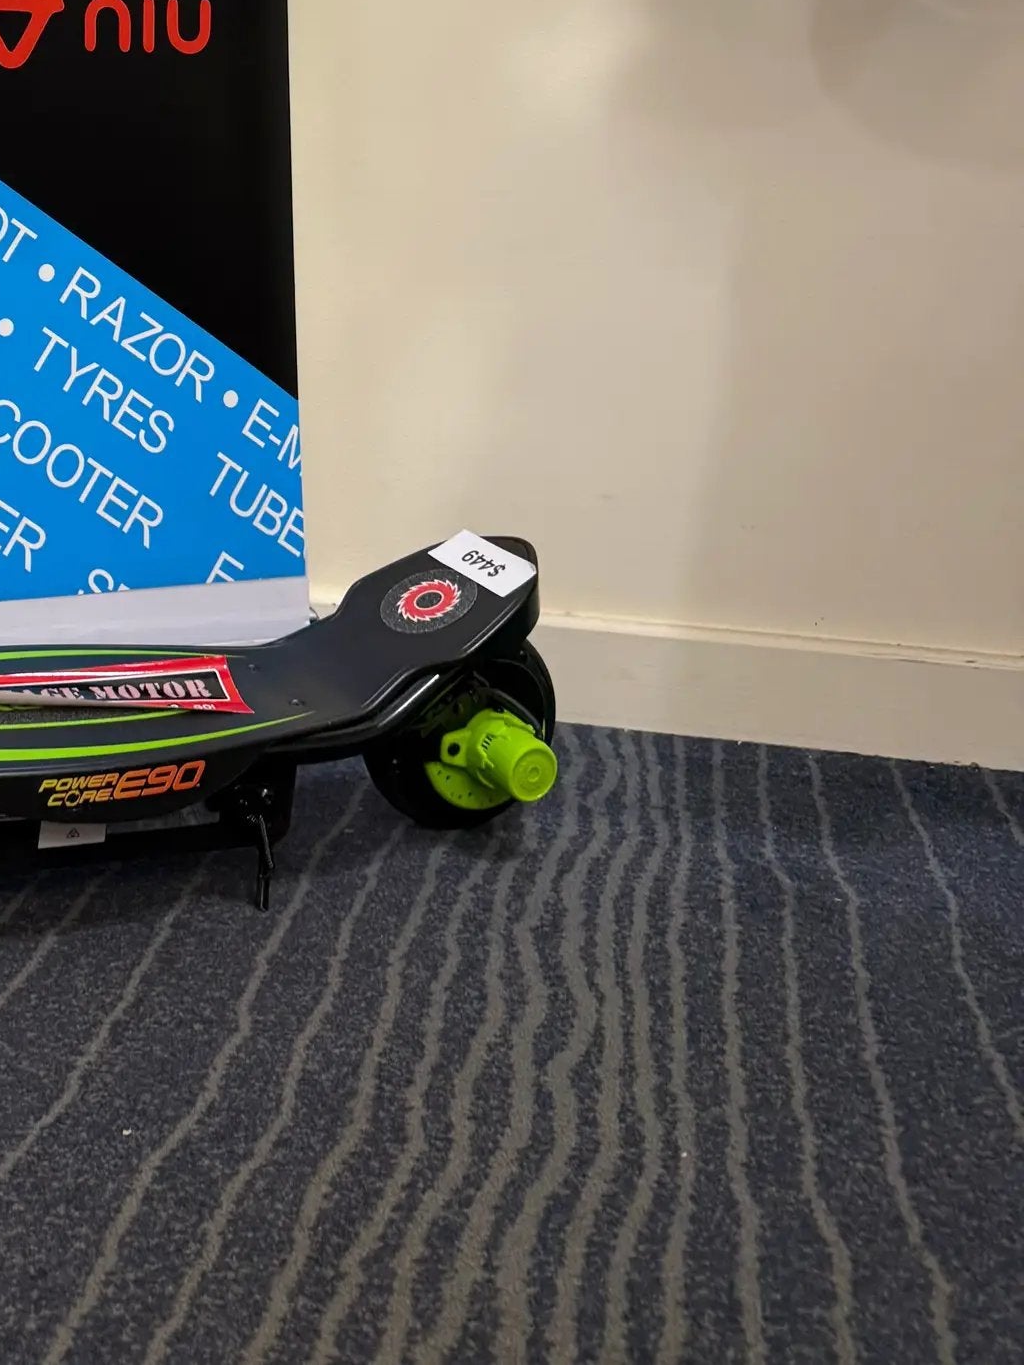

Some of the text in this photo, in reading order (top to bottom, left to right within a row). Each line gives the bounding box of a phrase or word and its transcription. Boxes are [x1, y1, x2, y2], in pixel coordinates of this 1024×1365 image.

[59, 266, 216, 404] RAZOR
[33, 327, 176, 454] TYRES
[209, 451, 306, 558] TUBE
[461, 550, 506, 578] $449
[89, 679, 212, 701] MOTOR
[38, 760, 206, 800] POWER E90
